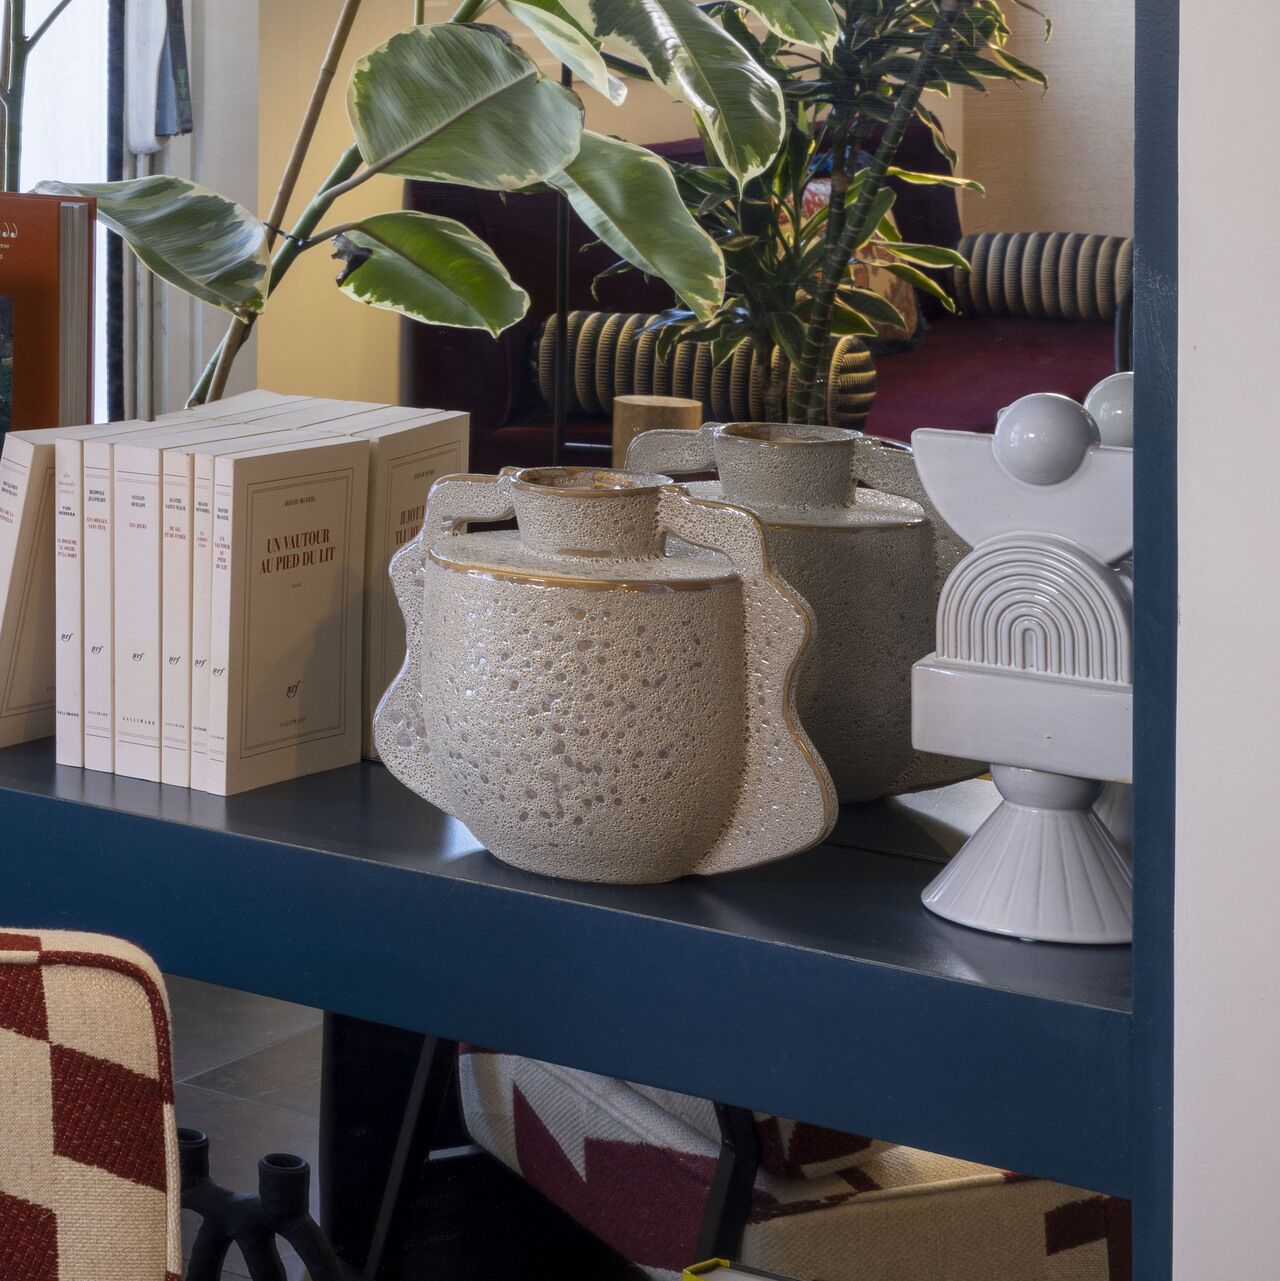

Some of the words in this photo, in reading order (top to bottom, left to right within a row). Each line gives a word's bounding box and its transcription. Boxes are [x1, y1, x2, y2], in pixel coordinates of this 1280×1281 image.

[267, 537, 282, 554] UN
[284, 529, 330, 550] VAUTOUR
[260, 558, 273, 574] AU
[275, 553, 300, 571] PIED
[302, 549, 318, 566] DU
[319, 546, 336, 563] LIT
